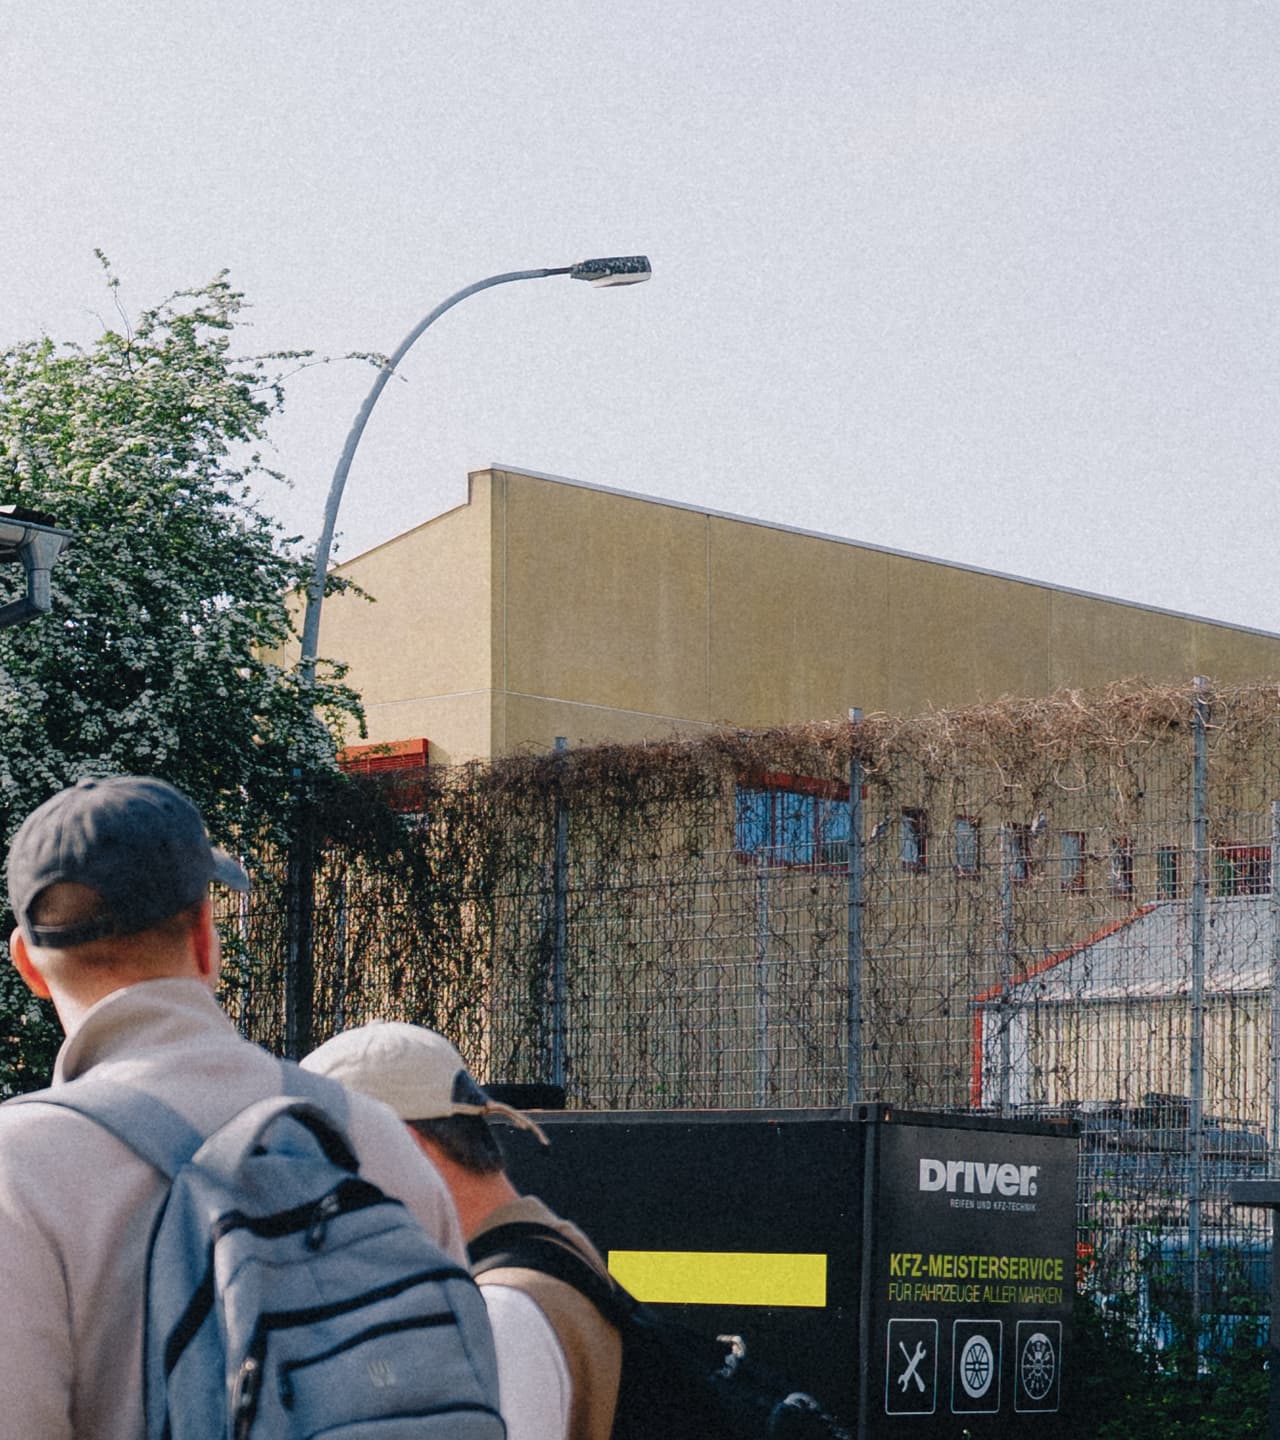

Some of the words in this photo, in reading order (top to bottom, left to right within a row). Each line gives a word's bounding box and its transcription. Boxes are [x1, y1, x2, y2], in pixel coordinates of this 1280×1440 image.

[950, 1198, 974, 1209] REIFEN
[976, 1199, 992, 1210] UND
[993, 1200, 1037, 1212] KFZ-TECHNIK
[889, 1252, 1064, 1281] KFZ-MEISTERSERVICE
[888, 1280, 912, 1302] FÜR
[914, 1283, 981, 1303] FAHRZEUGE
[983, 1285, 1017, 1303] ALLER
[1018, 1286, 1063, 1304] MARKEN
